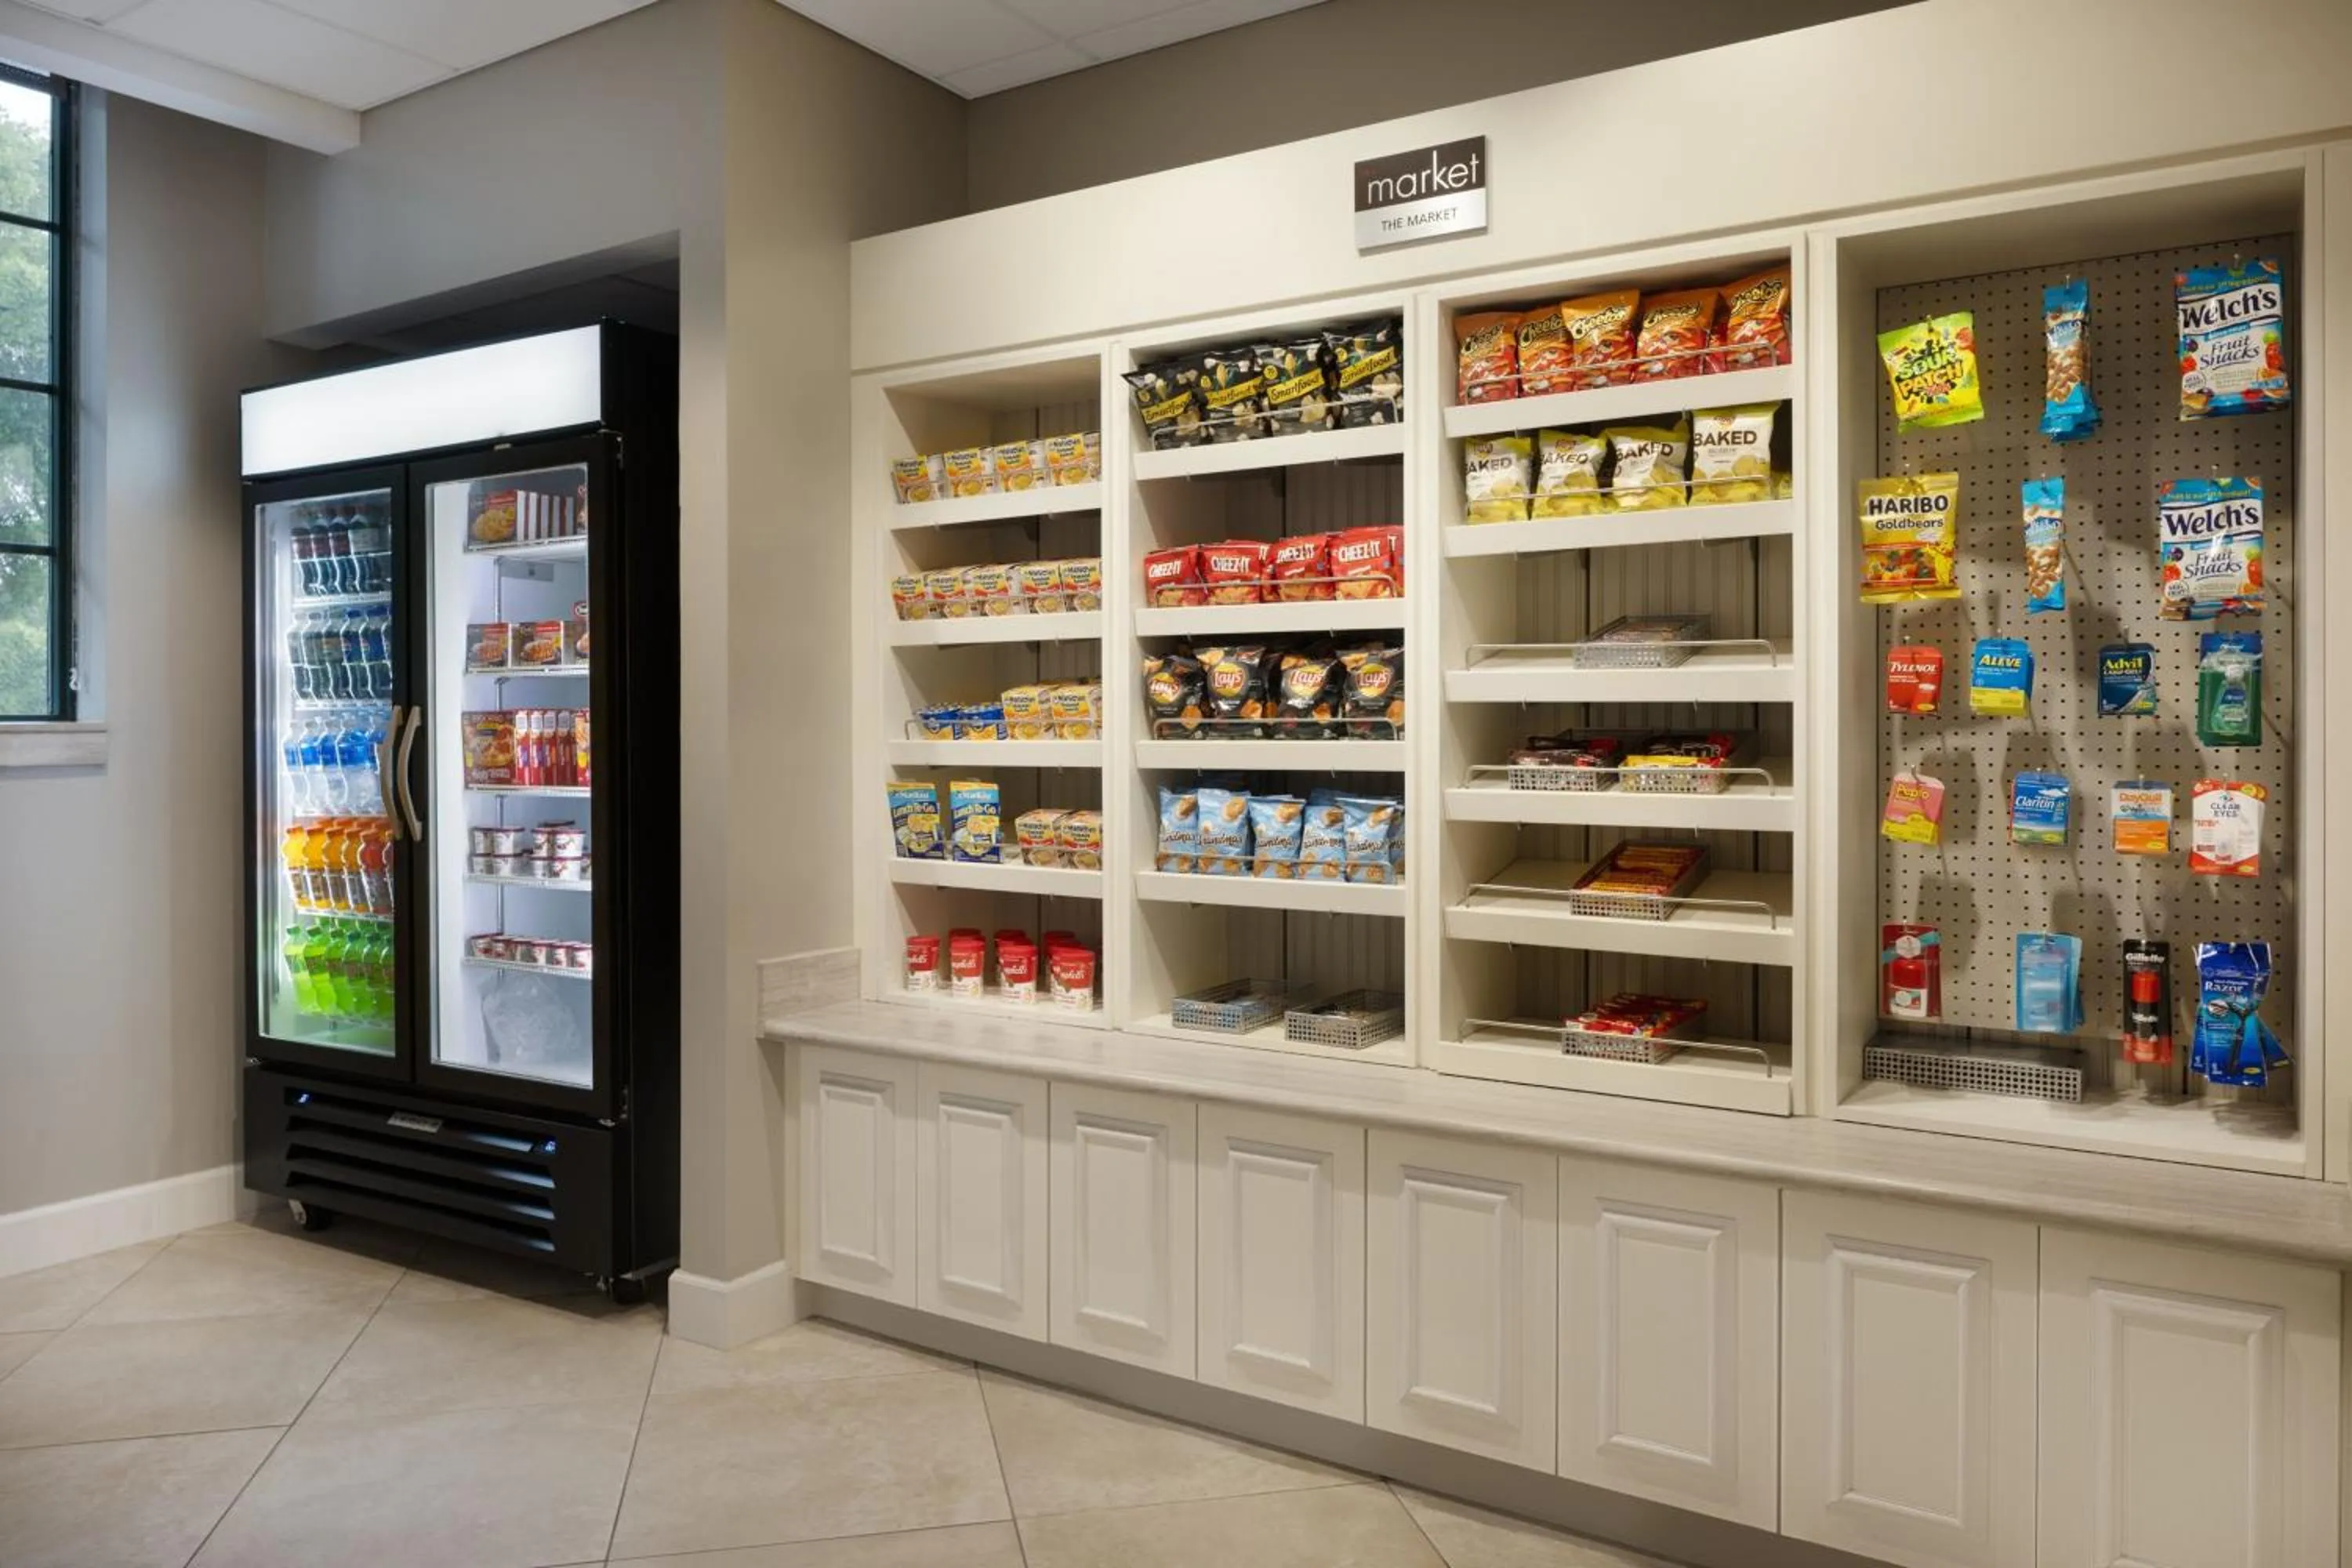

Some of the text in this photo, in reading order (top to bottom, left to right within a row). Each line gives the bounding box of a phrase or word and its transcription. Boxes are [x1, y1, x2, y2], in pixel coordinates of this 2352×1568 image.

[1367, 150, 1479, 204] market
[1381, 207, 1458, 231] THE MARKET
[2181, 289, 2278, 328] Welch's
[2212, 336, 2249, 354] Fruit
[2200, 346, 2259, 368] Snacks
[1693, 430, 1758, 447] BAKED
[1869, 495, 1949, 516] HARIBO
[1875, 518, 1944, 531] Goldbears
[2164, 503, 2259, 536] Welch's
[2183, 561, 2242, 579] Snacks
[2103, 657, 2143, 670] Advil
[2205, 981, 2245, 993] Razor
